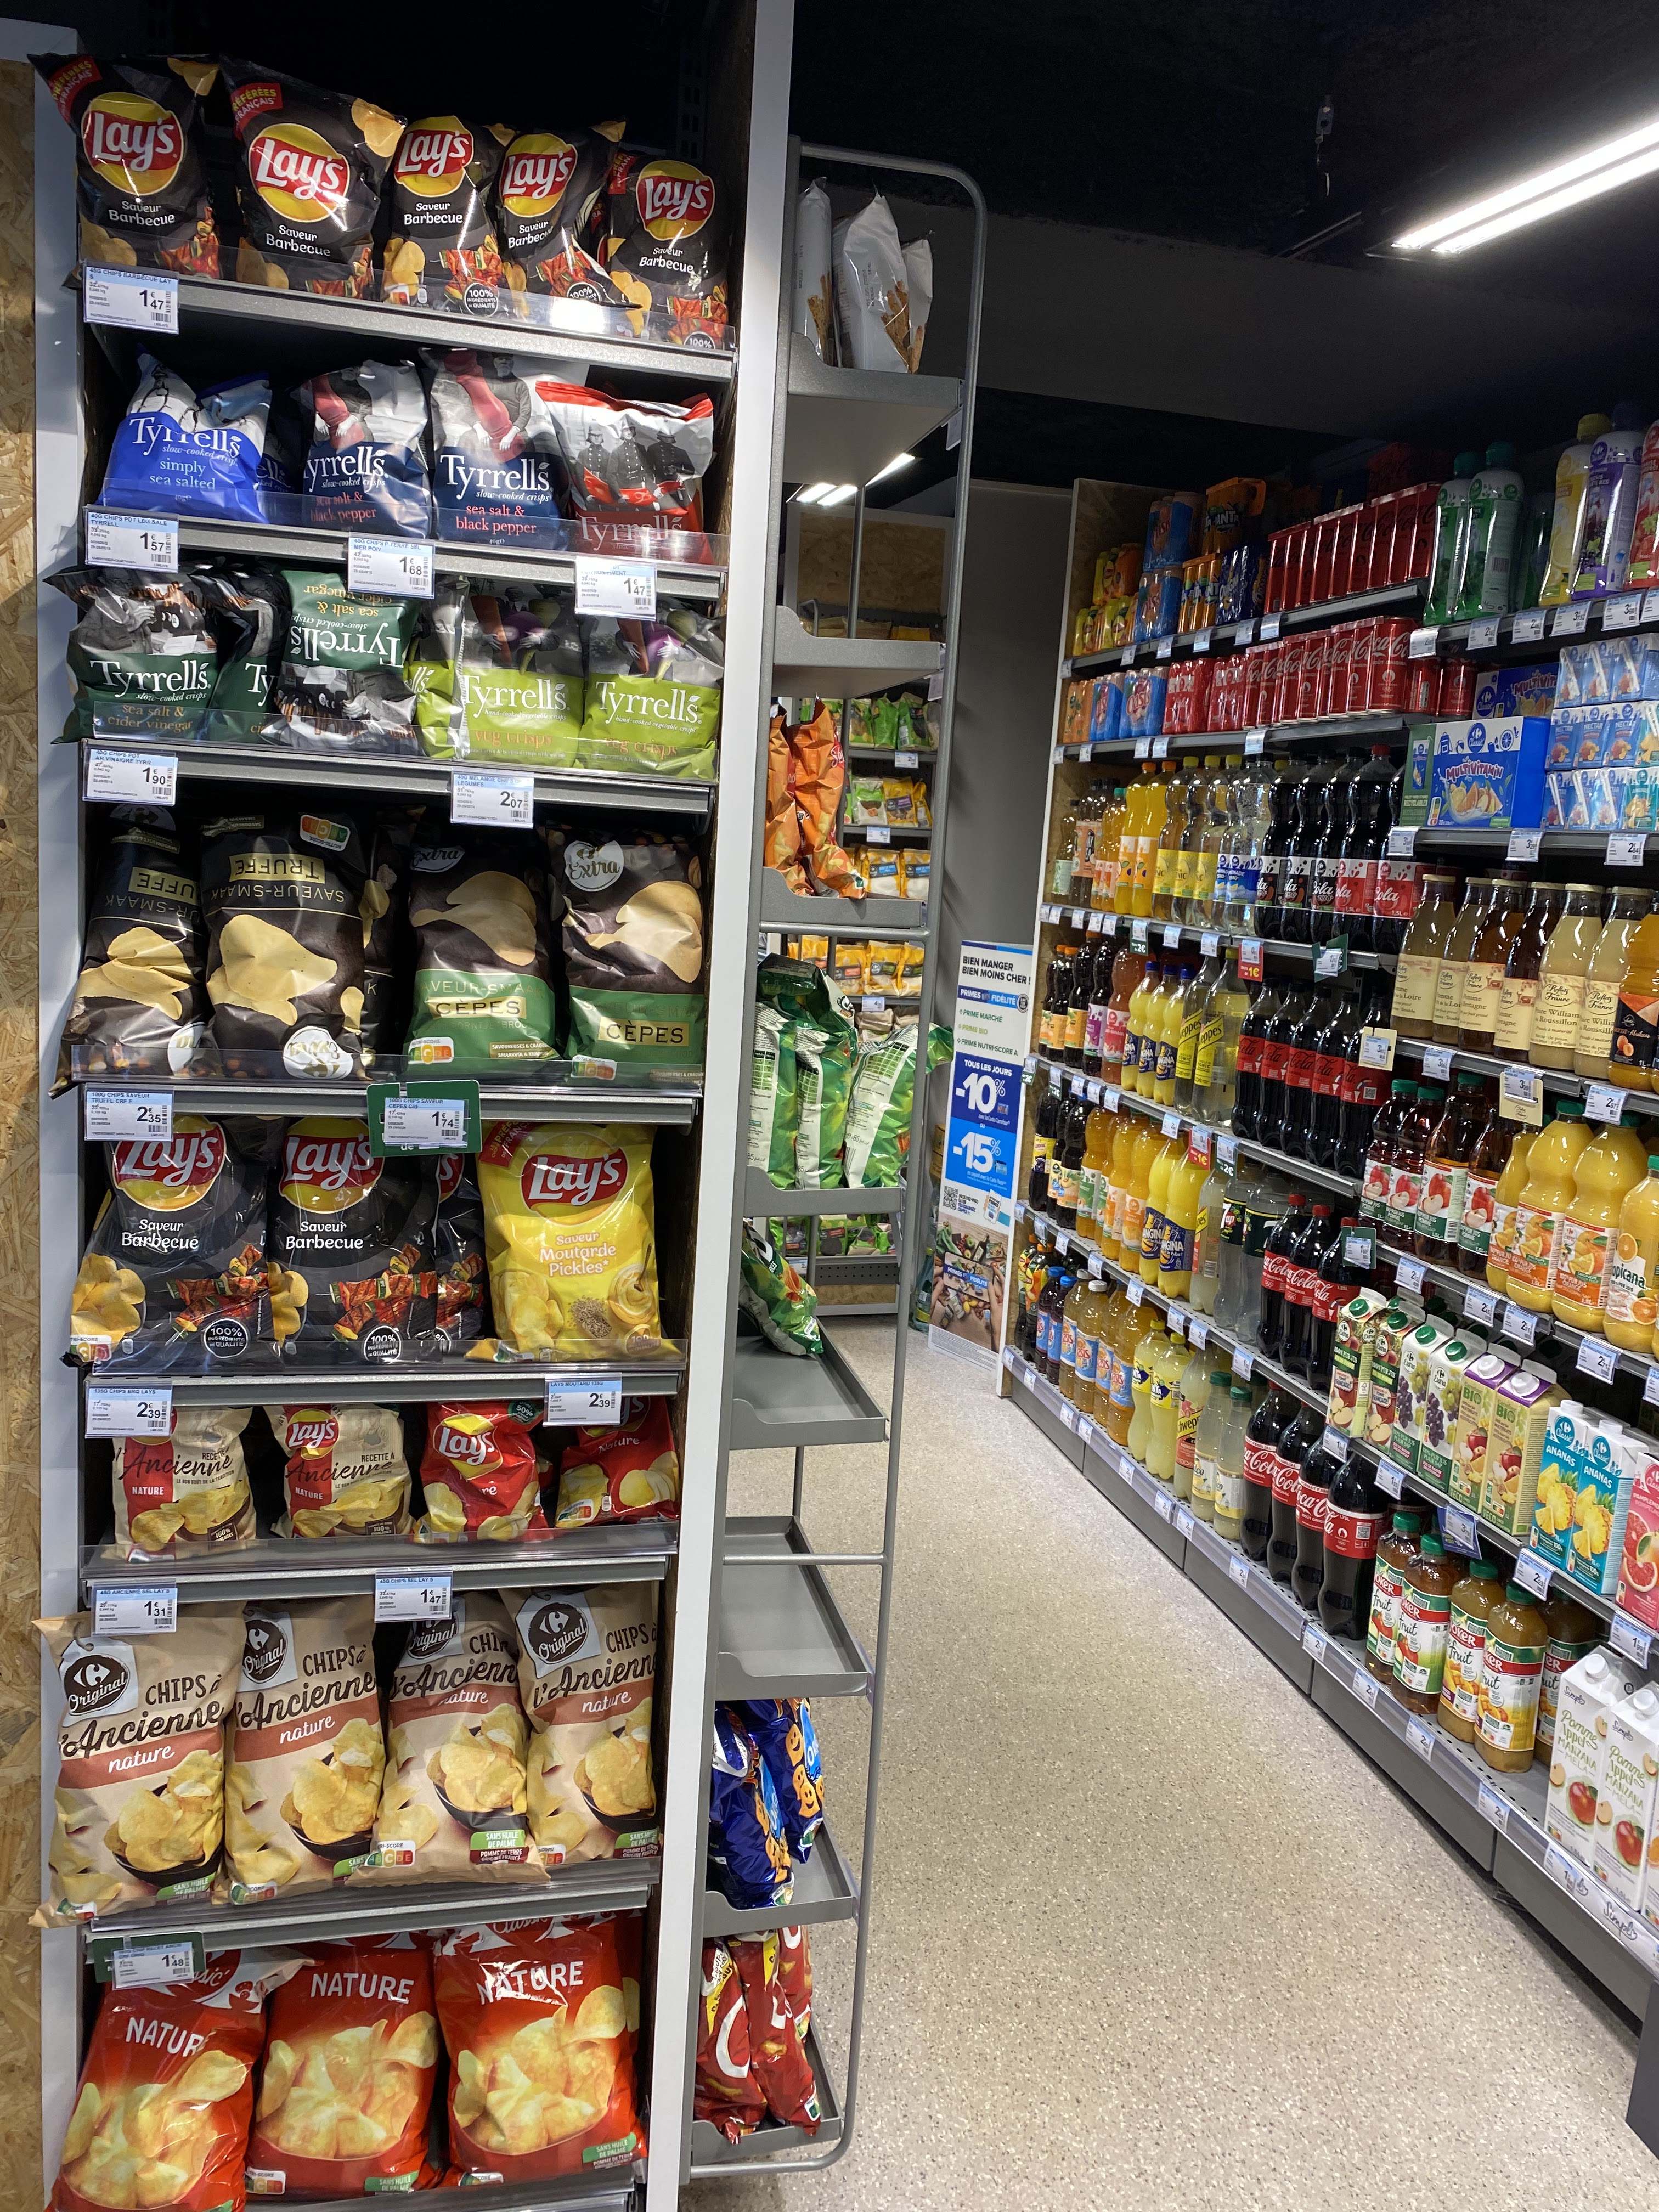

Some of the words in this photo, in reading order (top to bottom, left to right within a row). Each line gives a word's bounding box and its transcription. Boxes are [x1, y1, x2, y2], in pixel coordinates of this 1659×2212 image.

[92, 112, 175, 171] Lay's
[397, 129, 470, 177] Lay's
[256, 138, 343, 201] Lay's
[503, 150, 573, 199] Lay's
[121, 200, 161, 213] Saveur
[416, 201, 450, 212] Saveur
[644, 177, 711, 221] Lay's
[109, 208, 175, 227] Barbecue
[404, 212, 463, 225] Barbecue
[279, 224, 317, 241] Saveur
[519, 221, 549, 235] Saveur
[266, 233, 331, 257] Barbecue
[652, 246, 683, 257] Saveur
[639, 256, 694, 274] Barbecue
[469, 289, 493, 297] 100%
[160, 458, 207, 476] simply
[150, 474, 171, 487] sea
[176, 475, 215, 489] salted
[476, 490, 524, 502] slow-cooked
[526, 492, 550, 503] crisps
[456, 517, 489, 532] black
[493, 520, 537, 535] pepper
[304, 584, 356, 599] vinegar
[331, 602, 353, 617] salt
[358, 605, 379, 617] sea
[136, 692, 183, 702] slow-cooked
[185, 691, 207, 701] crisps
[122, 704, 143, 716] sea
[148, 706, 171, 717] salt
[174, 706, 184, 717] &
[108, 715, 143, 730] cider
[146, 719, 193, 733] vinegar
[616, 715, 651, 726] hand-cooked
[234, 859, 320, 879] TRUFFE
[568, 858, 620, 880] Extra
[963, 956, 979, 966] BIEN
[981, 958, 1013, 971] MANGER
[962, 966, 979, 975] BIEN
[980, 969, 1005, 981] MOINS
[1006, 975, 1027, 984] CHER
[960, 989, 981, 999] PRIMES
[991, 992, 1015, 1005] FIDÉLITÉ
[436, 999, 521, 1015] CÈPES
[963, 1009, 979, 1018] PRIME
[980, 1012, 1002, 1023] MARCHÉ
[606, 1022, 684, 1043] CÈPES
[962, 1024, 978, 1032] PRIME
[961, 1038, 977, 1047] PRIME
[978, 1041, 1013, 1055] NUTRI-SCORE
[964, 1059, 980, 1069] TOUS
[981, 1061, 991, 1071] LES
[992, 1065, 1012, 1076] JOURS
[283, 1133, 373, 1190] Lay's
[528, 1153, 620, 1206] Lay's
[139, 1219, 184, 1233] Saveur
[300, 1221, 347, 1233] Saveur
[122, 1232, 199, 1252] Barbecue
[285, 1235, 364, 1250] Barbecue
[556, 1233, 599, 1245] Saveur
[539, 1243, 616, 1262] Moutarde
[210, 1328, 242, 1337] 100%
[216, 1340, 244, 1348] QUALITÉ
[1463, 1386, 1481, 1404] BIO
[1497, 1404, 1515, 1423] BIO
[289, 1420, 335, 1448] Lay's
[598, 1435, 640, 1454] Nature
[361, 1453, 388, 1463] RECETTE
[1546, 1444, 1576, 1466] ANANAS
[1584, 1465, 1612, 1488] ANANAS
[132, 1487, 164, 1496] NATURE
[295, 1487, 323, 1500] NATURE
[1373, 1592, 1391, 1611] fruit
[538, 1618, 586, 1659] Original
[606, 1623, 649, 1653] CHIPS
[244, 1639, 285, 1673] Original
[303, 1646, 355, 1676] CHIPS
[69, 1672, 127, 1712] Original
[145, 1674, 206, 1705] CHIPS
[582, 1691, 631, 1713] nature
[280, 1716, 335, 1743] nature
[108, 1746, 175, 1773] nature
[1558, 1737, 1596, 1769] MANZANA
[486, 1832, 502, 1841] SANS
[503, 1831, 518, 1839] HUILE
[498, 1838, 516, 1847] PALME
[311, 1972, 415, 2005] NATURE
[477, 1961, 584, 2005] NATURE
